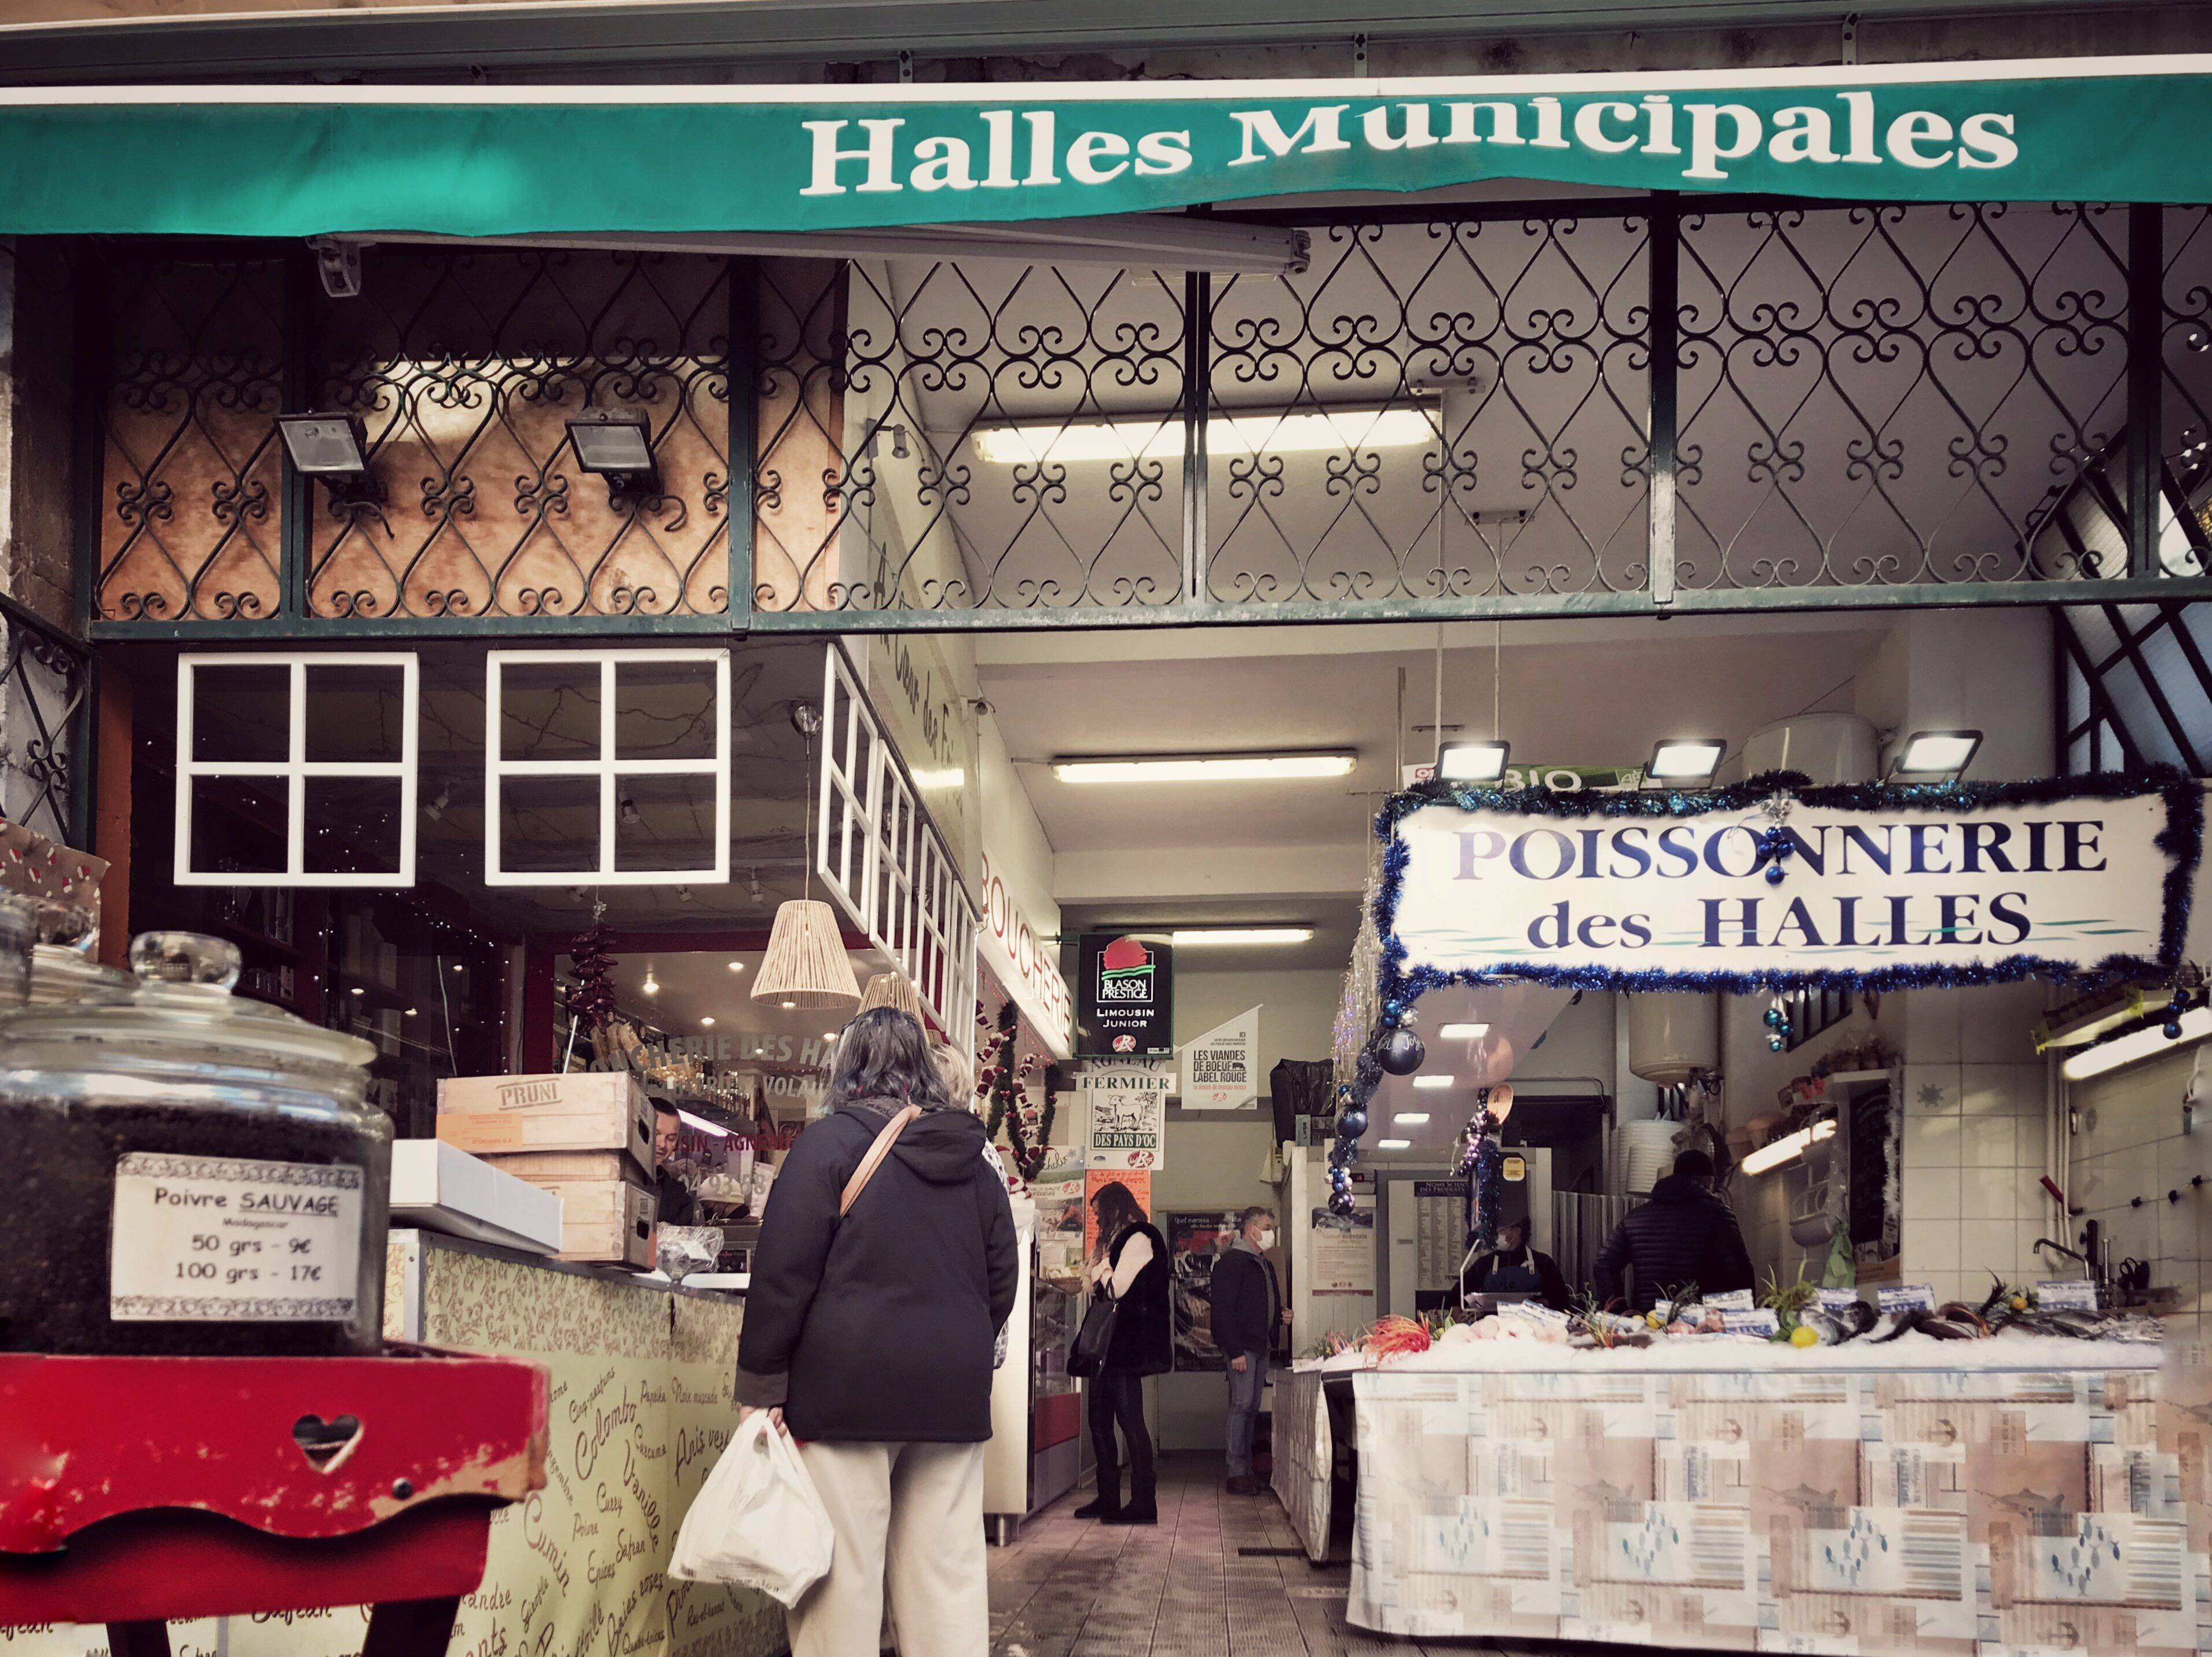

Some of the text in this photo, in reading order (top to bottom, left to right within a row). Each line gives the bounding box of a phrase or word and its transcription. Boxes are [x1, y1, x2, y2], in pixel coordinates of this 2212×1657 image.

[800, 92, 2020, 197] Halles Municipales
[1504, 770, 1582, 791] BIO
[1453, 820, 2108, 881] POISSONNERIE
[1526, 892, 2032, 949] des HALLES
[1102, 989, 1148, 999] PRESTIGE
[1104, 979, 1146, 989] BLASON
[1097, 1008, 1155, 1017] LIMOUSIN
[1103, 1019, 1147, 1027] JUNIOR
[740, 1034, 792, 1062] DES
[1193, 1050, 1246, 1060] LES VIANDES
[1193, 1061, 1204, 1071] DE
[1082, 1077, 1170, 1089] FERMIER
[1193, 1072, 1247, 1082] LABEL ROUGE
[501, 1082, 558, 1106] PRUNI
[673, 1135, 708, 1152] SIN
[724, 1135, 790, 1151] AGNEAU
[1095, 1134, 1156, 1147] DES PAYS D'OC
[154, 1186, 340, 1214] Poivre SAUVAGE
[222, 1217, 289, 1231] Madagascar
[192, 1235, 219, 1252] 50
[230, 1240, 262, 1256] grs
[289, 1238, 312, 1254] 9€
[175, 1263, 216, 1279] 100
[226, 1267, 259, 1284] grs
[290, 1265, 321, 1281] 17€
[576, 1385, 636, 1480] Colombo
[634, 1424, 667, 1460] Curcuma
[596, 1481, 624, 1519] Curry
[623, 1439, 660, 1553] Vanille
[524, 1491, 570, 1598] Cumin
